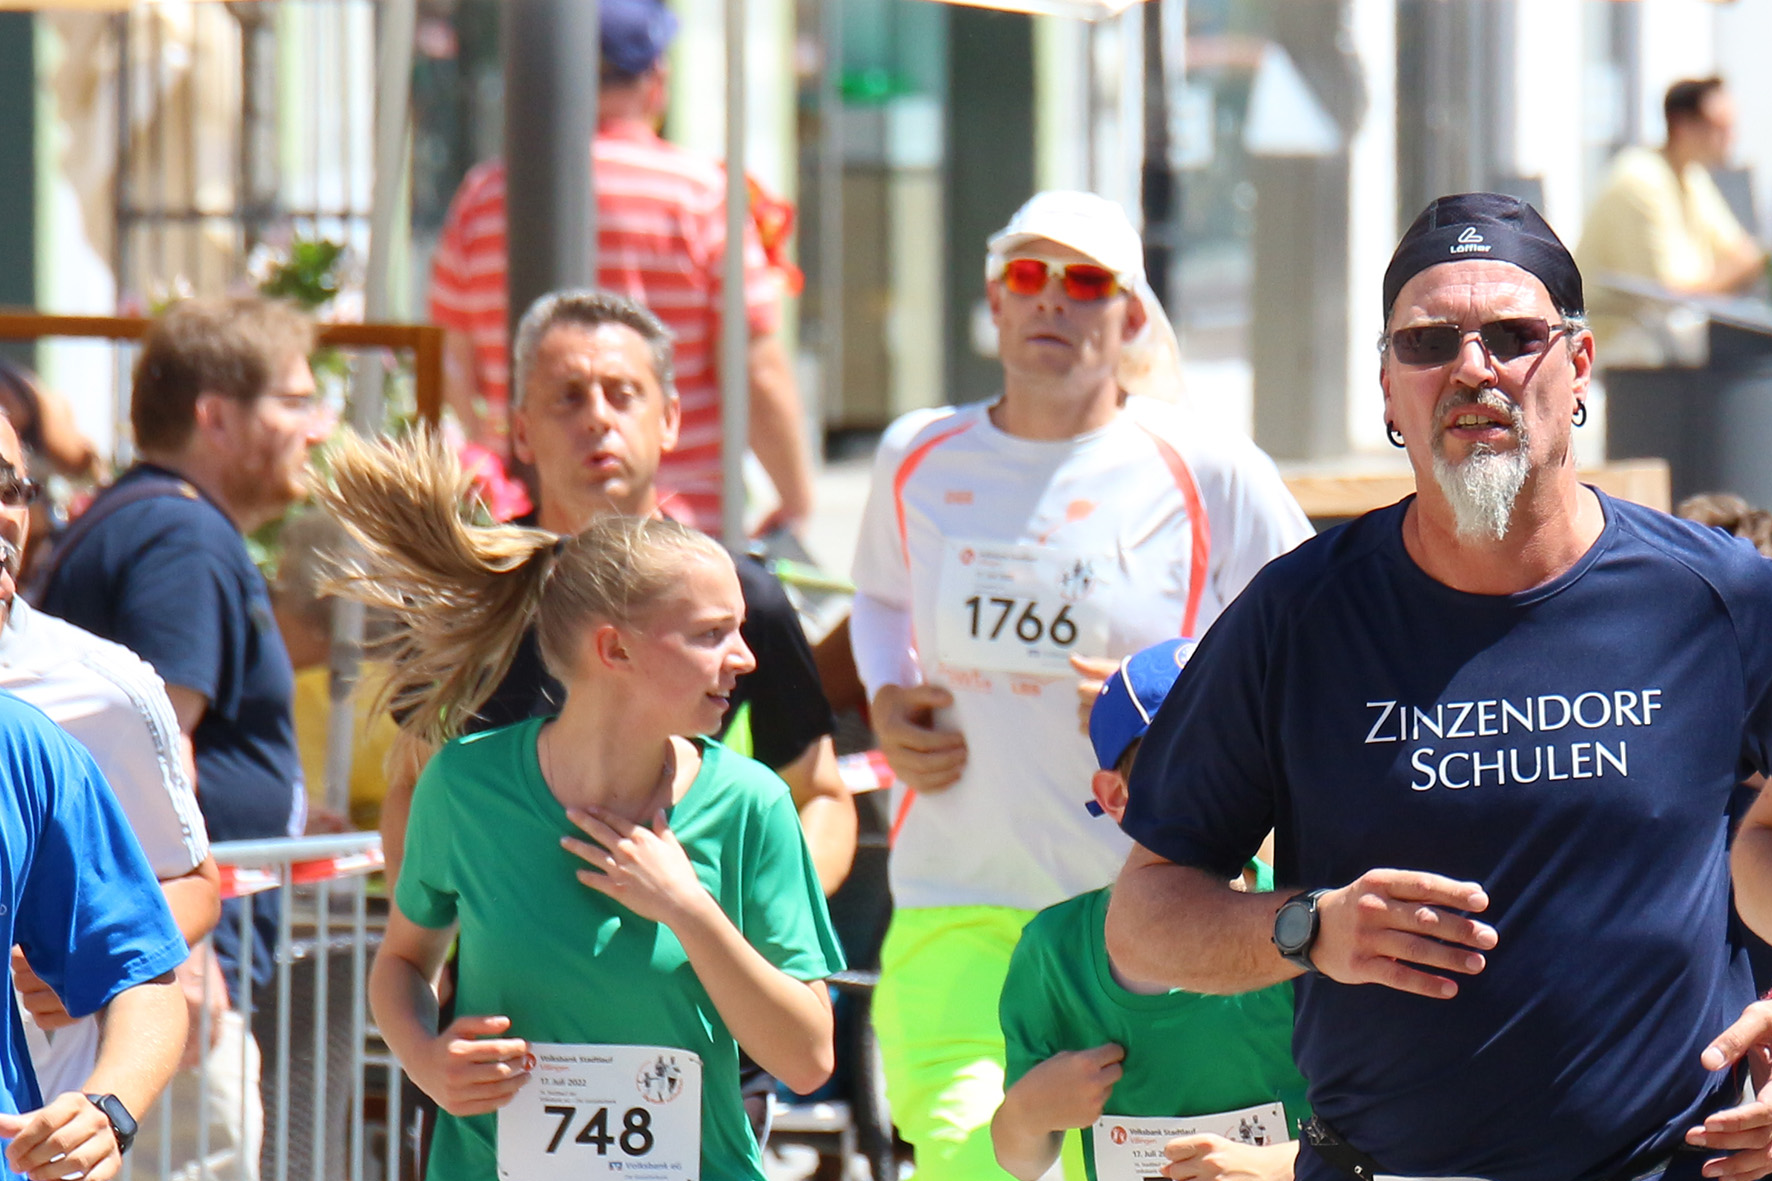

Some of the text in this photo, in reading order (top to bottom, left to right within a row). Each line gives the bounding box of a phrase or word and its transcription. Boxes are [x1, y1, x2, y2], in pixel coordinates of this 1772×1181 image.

[965, 596, 1077, 645] 1766
[1364, 688, 1662, 743] ZINZENDORF
[1410, 741, 1627, 791] SCHULEN
[544, 1105, 654, 1156] 748
